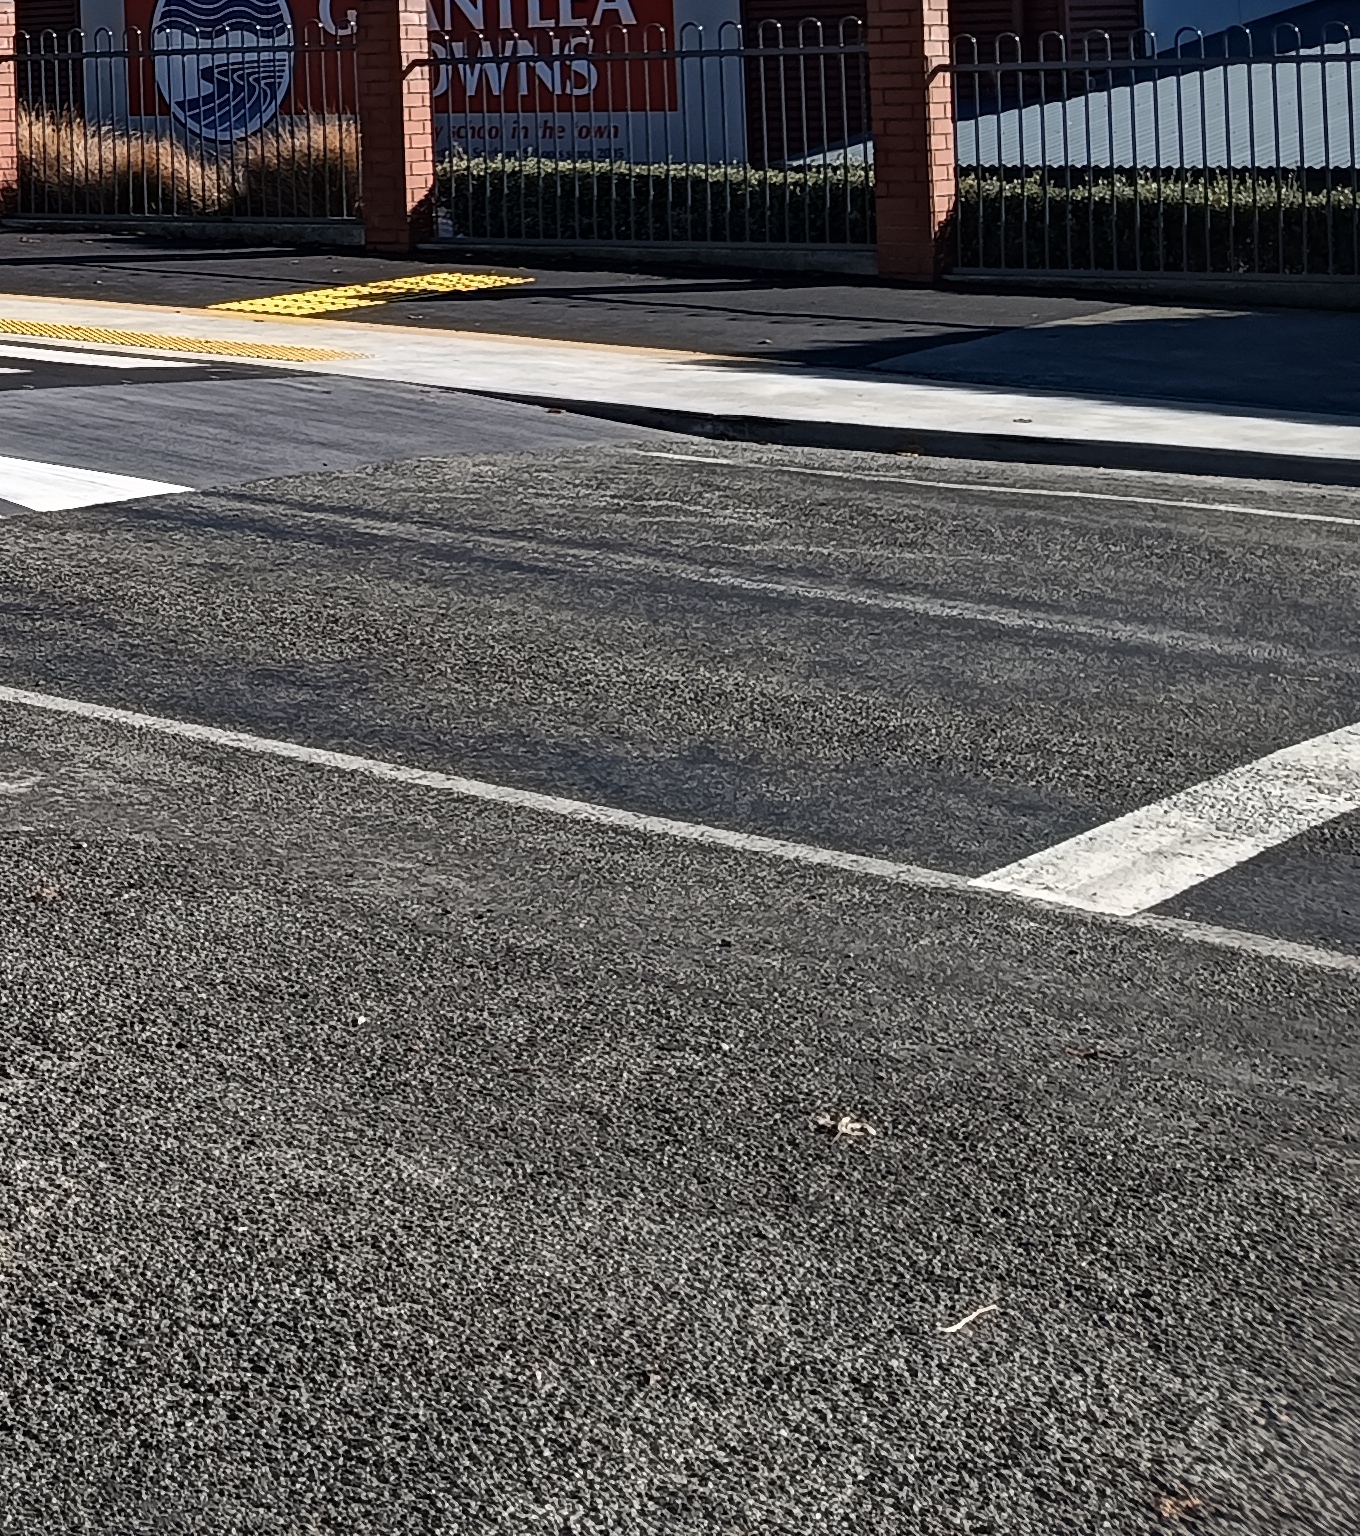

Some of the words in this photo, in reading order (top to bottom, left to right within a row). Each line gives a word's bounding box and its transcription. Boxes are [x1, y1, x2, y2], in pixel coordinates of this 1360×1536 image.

[448, 120, 502, 140] schoo
[538, 119, 567, 140] he
[574, 121, 620, 140] own
